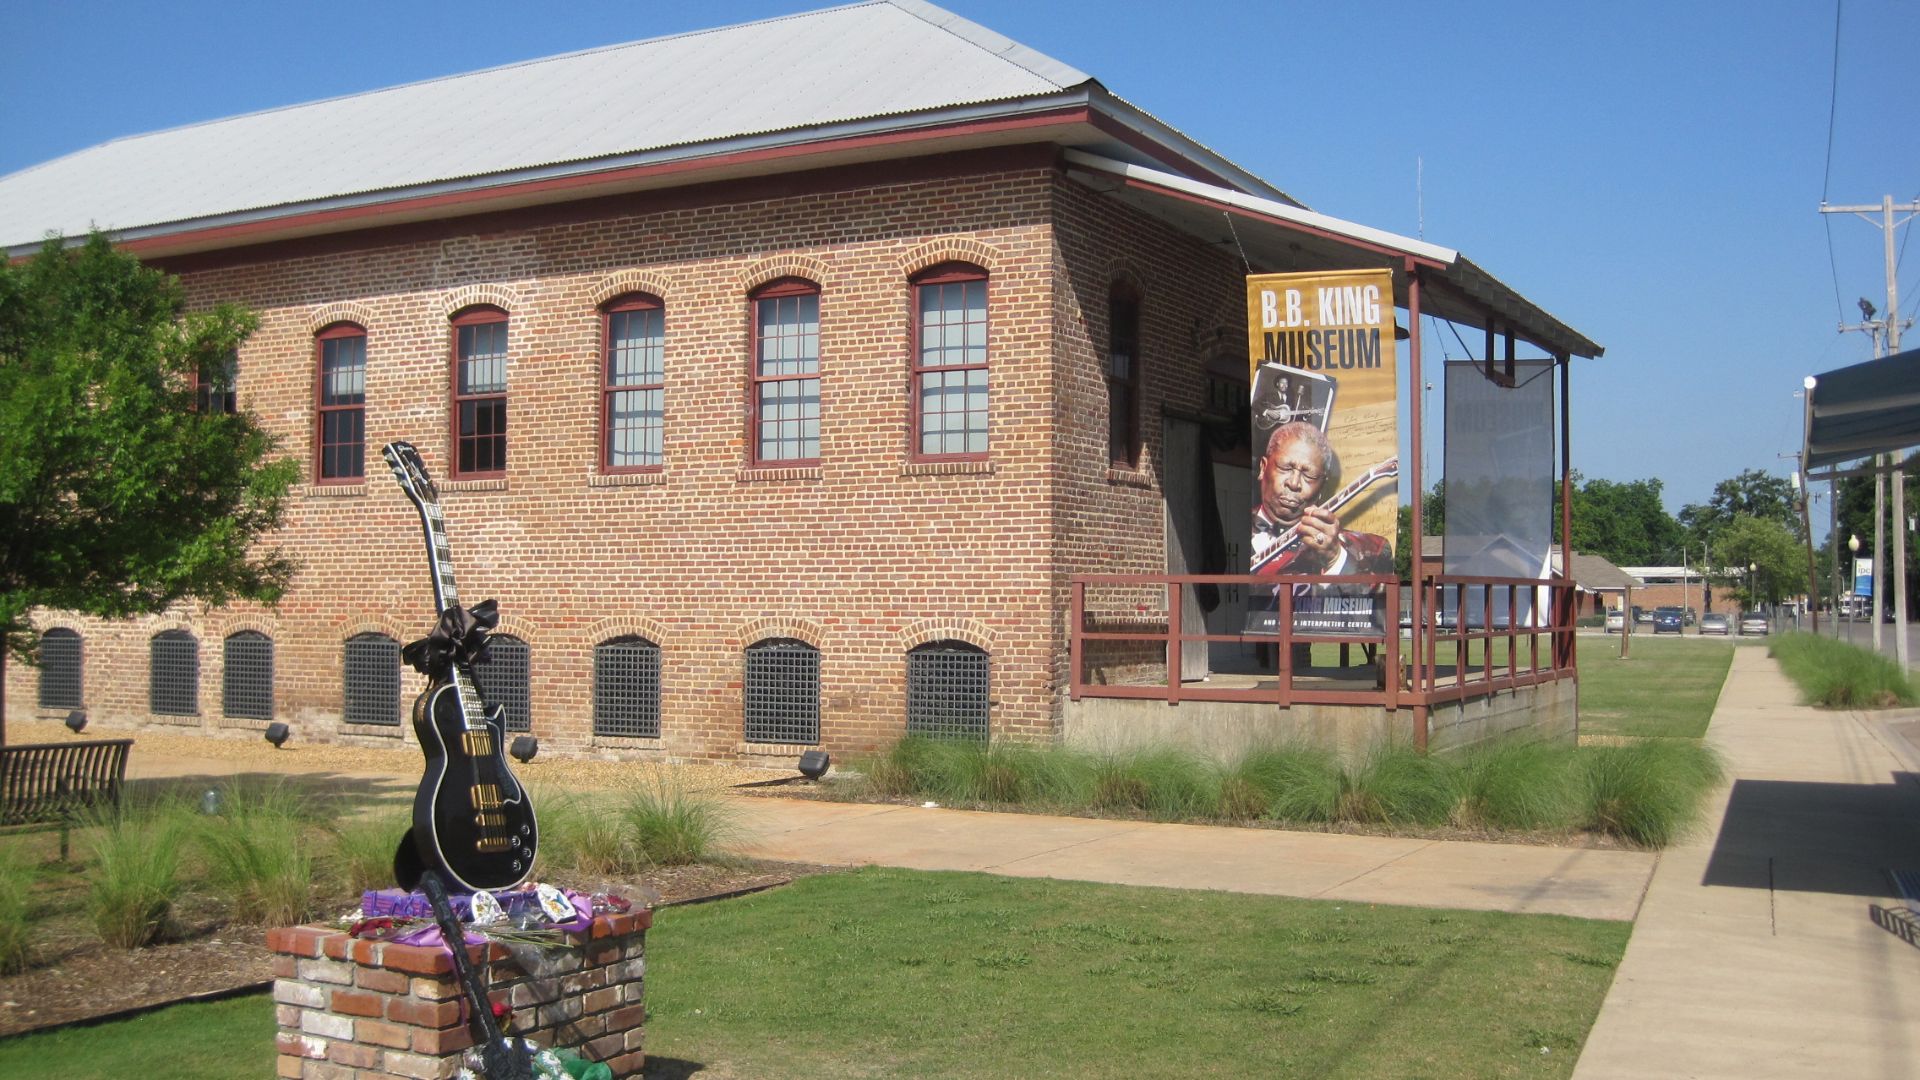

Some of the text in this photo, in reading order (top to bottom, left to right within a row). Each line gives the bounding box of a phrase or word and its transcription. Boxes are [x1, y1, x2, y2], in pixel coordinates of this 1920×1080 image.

[1261, 285, 1381, 328] B.B. KING
[1264, 327, 1381, 370] MUSEUM
[1323, 598, 1373, 615] MUSEUM
[1300, 620, 1345, 628] INTERPRETIVE
